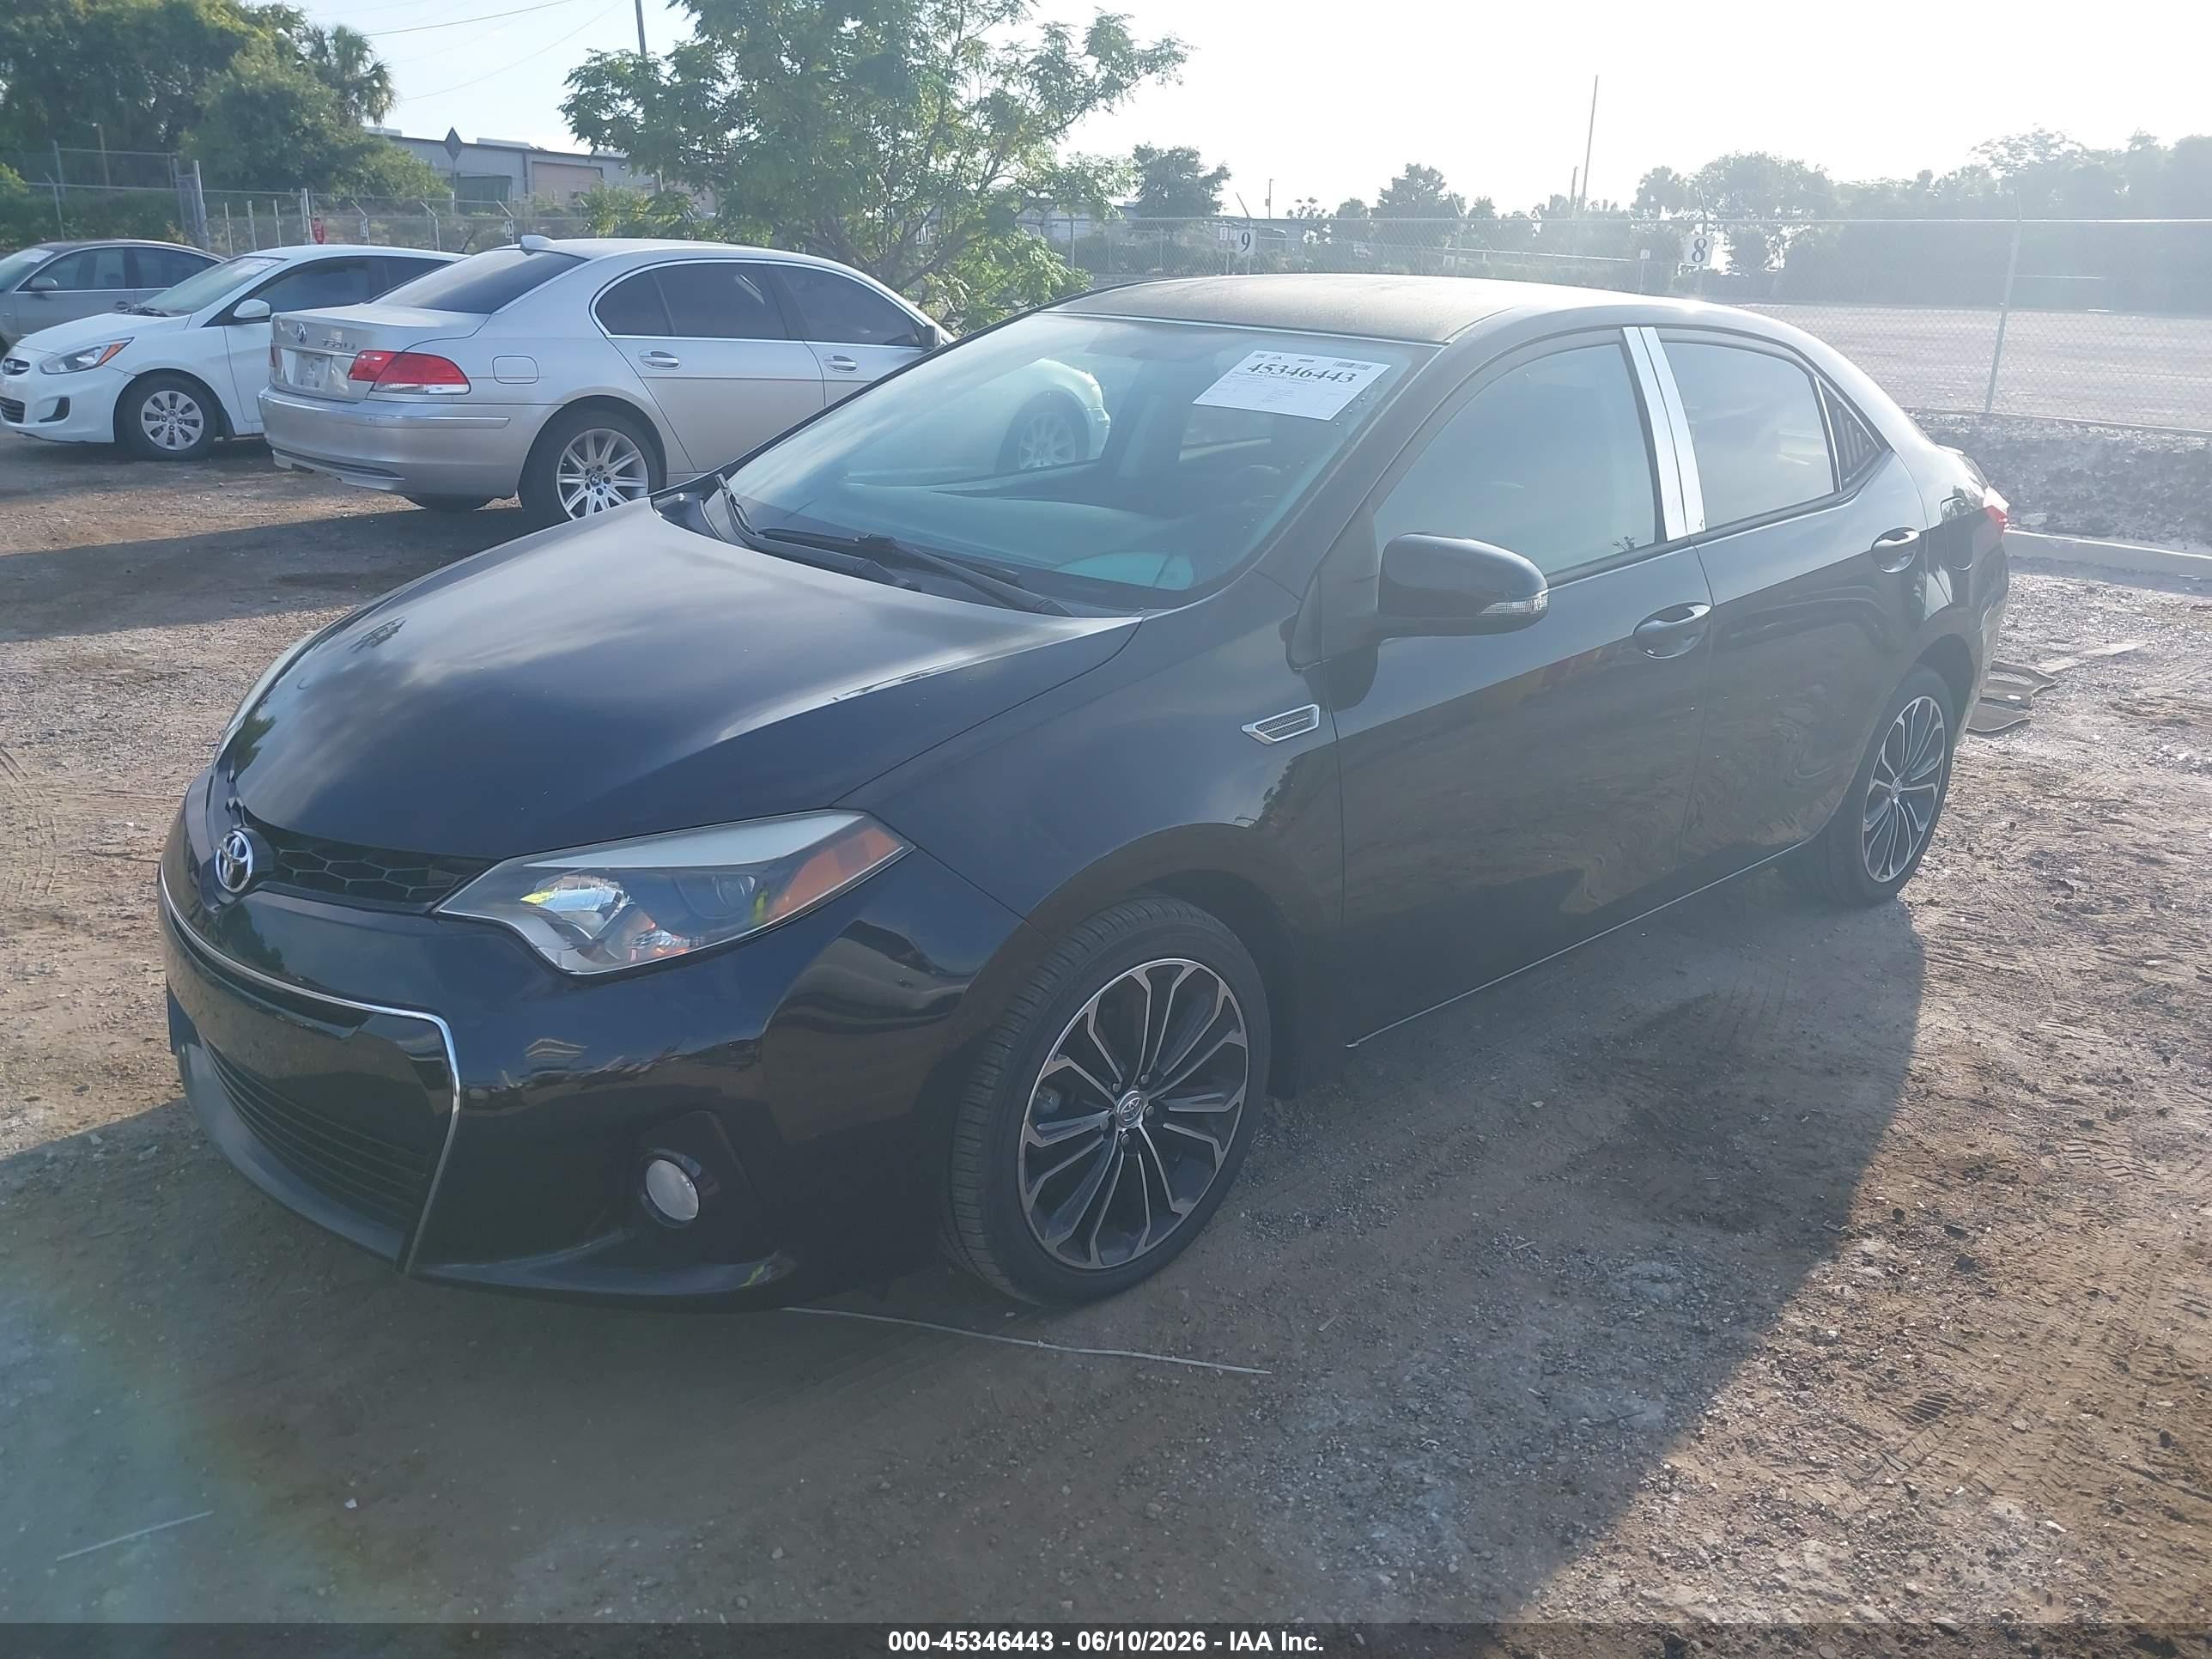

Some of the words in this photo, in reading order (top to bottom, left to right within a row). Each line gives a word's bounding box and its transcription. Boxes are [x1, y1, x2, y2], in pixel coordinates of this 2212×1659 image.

[1240, 232, 1251, 253] 9
[1691, 238, 1708, 263] 8
[1247, 362, 1358, 384] 45346443
